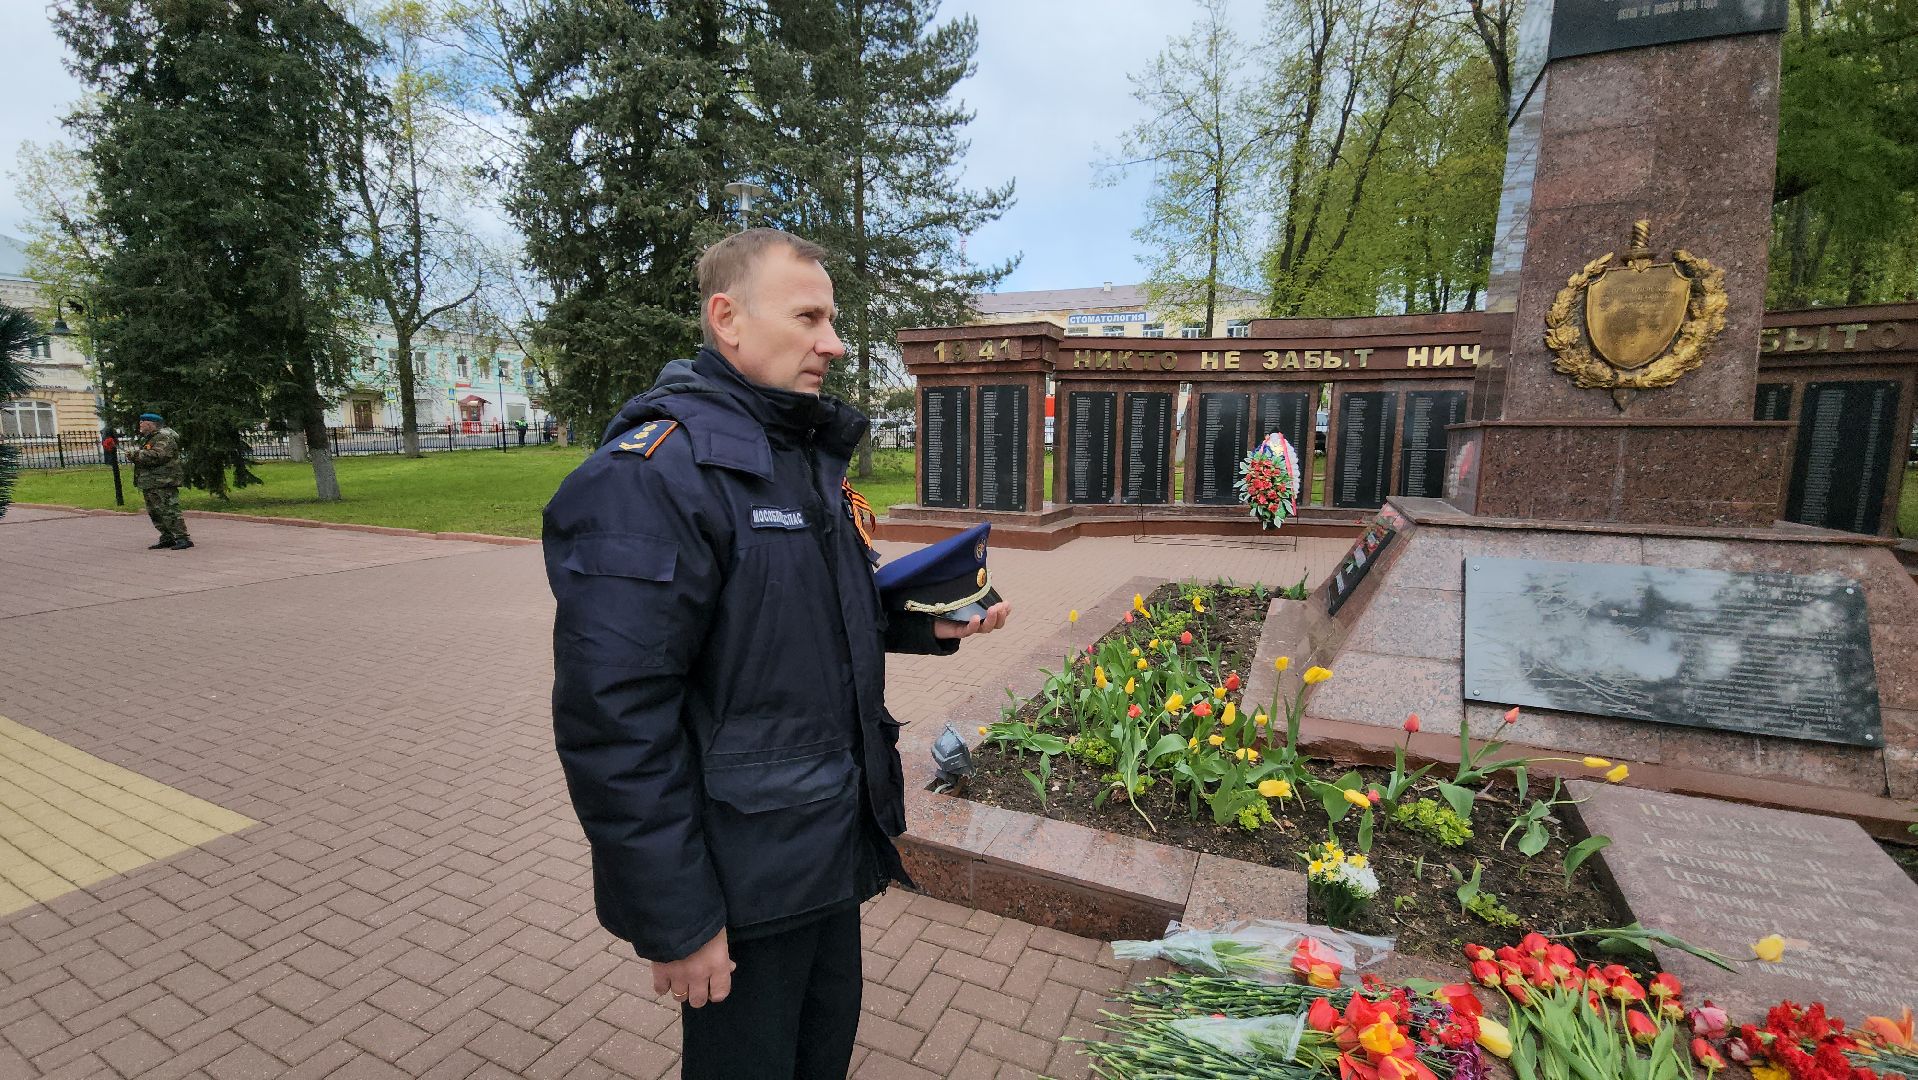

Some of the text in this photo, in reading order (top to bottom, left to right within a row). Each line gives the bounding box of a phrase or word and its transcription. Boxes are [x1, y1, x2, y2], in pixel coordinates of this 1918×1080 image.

[1069, 313, 1145, 324] СТОМАТОЛОГИЯ
[933, 338, 1011, 363] 1941
[1073, 350, 1178, 370] НИКТО
[1201, 350, 1241, 370] НЕ
[1262, 349, 1375, 370] ЗАБЫТ
[1406, 344, 1481, 368] НИЧ
